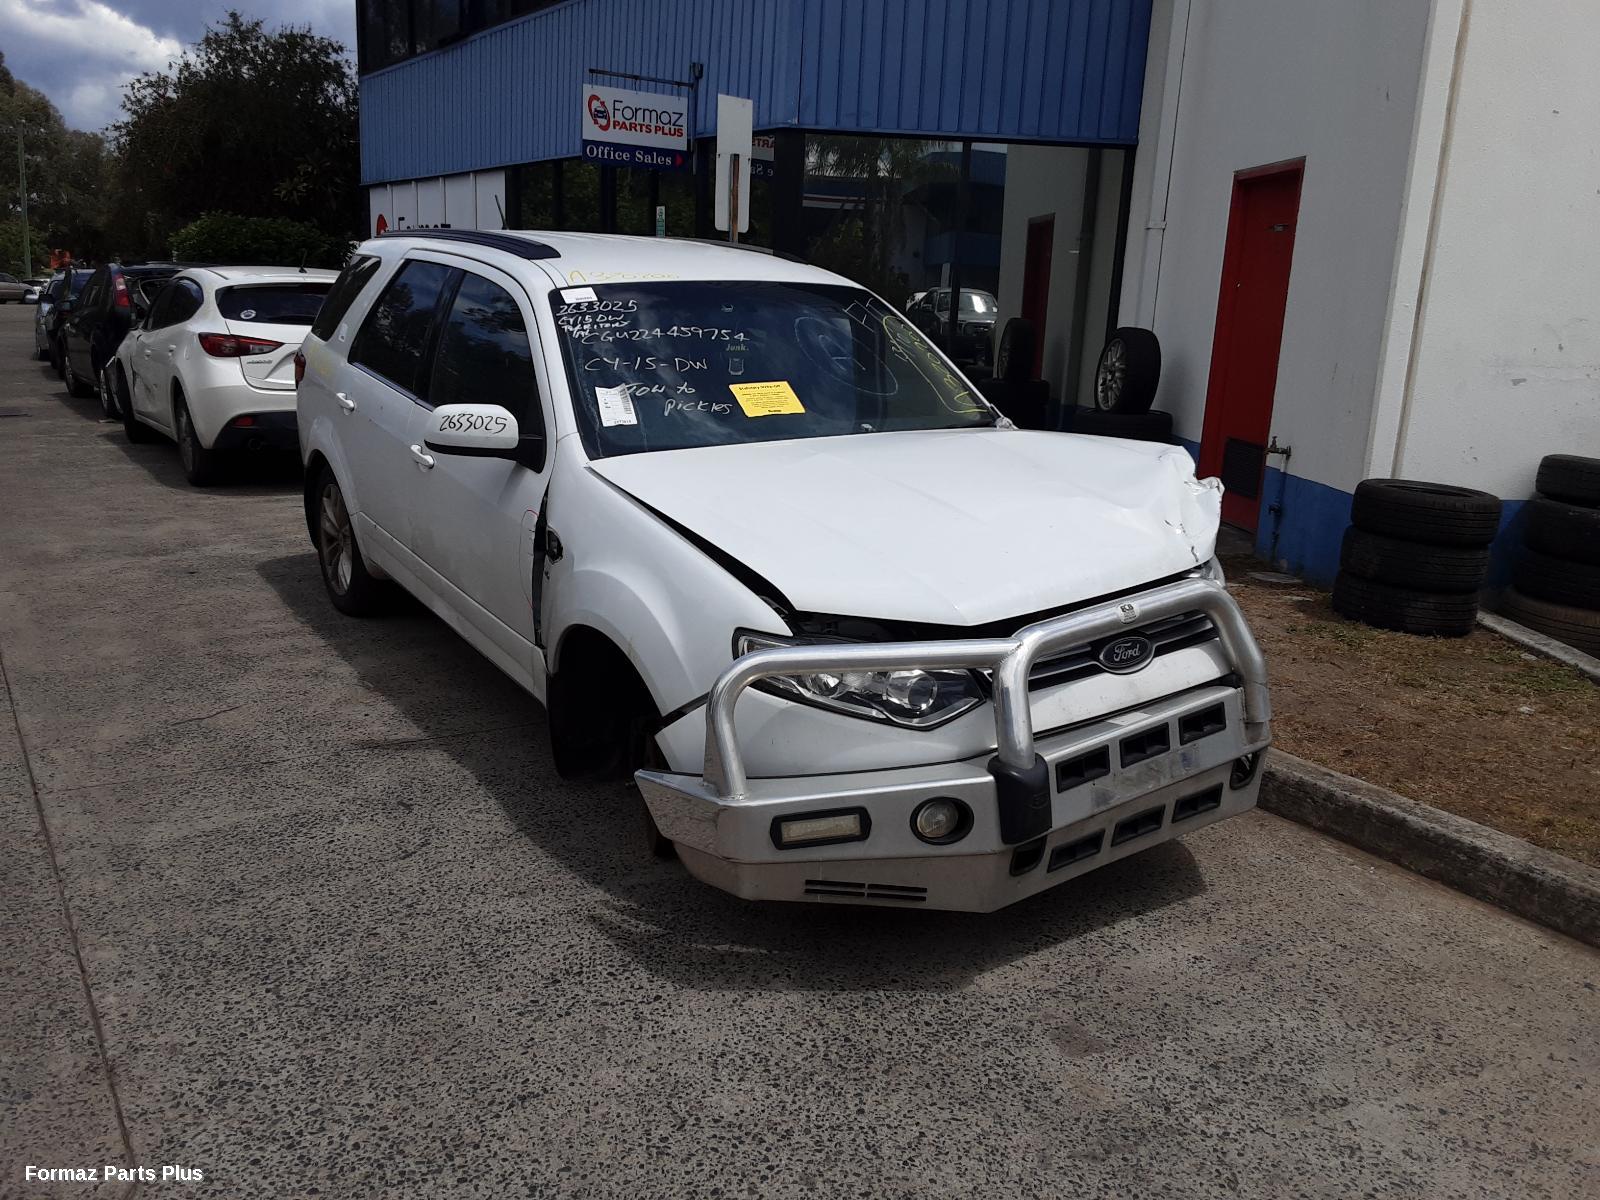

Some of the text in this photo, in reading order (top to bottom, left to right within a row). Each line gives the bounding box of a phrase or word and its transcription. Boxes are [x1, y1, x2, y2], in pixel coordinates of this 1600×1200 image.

[612, 99, 684, 128] Formaz
[612, 120, 684, 138] PARTS PLUS
[586, 144, 672, 166] Office Sales
[556, 299, 638, 317] 2633025
[439, 413, 508, 435] 2633025
[1113, 641, 1141, 662] Ford
